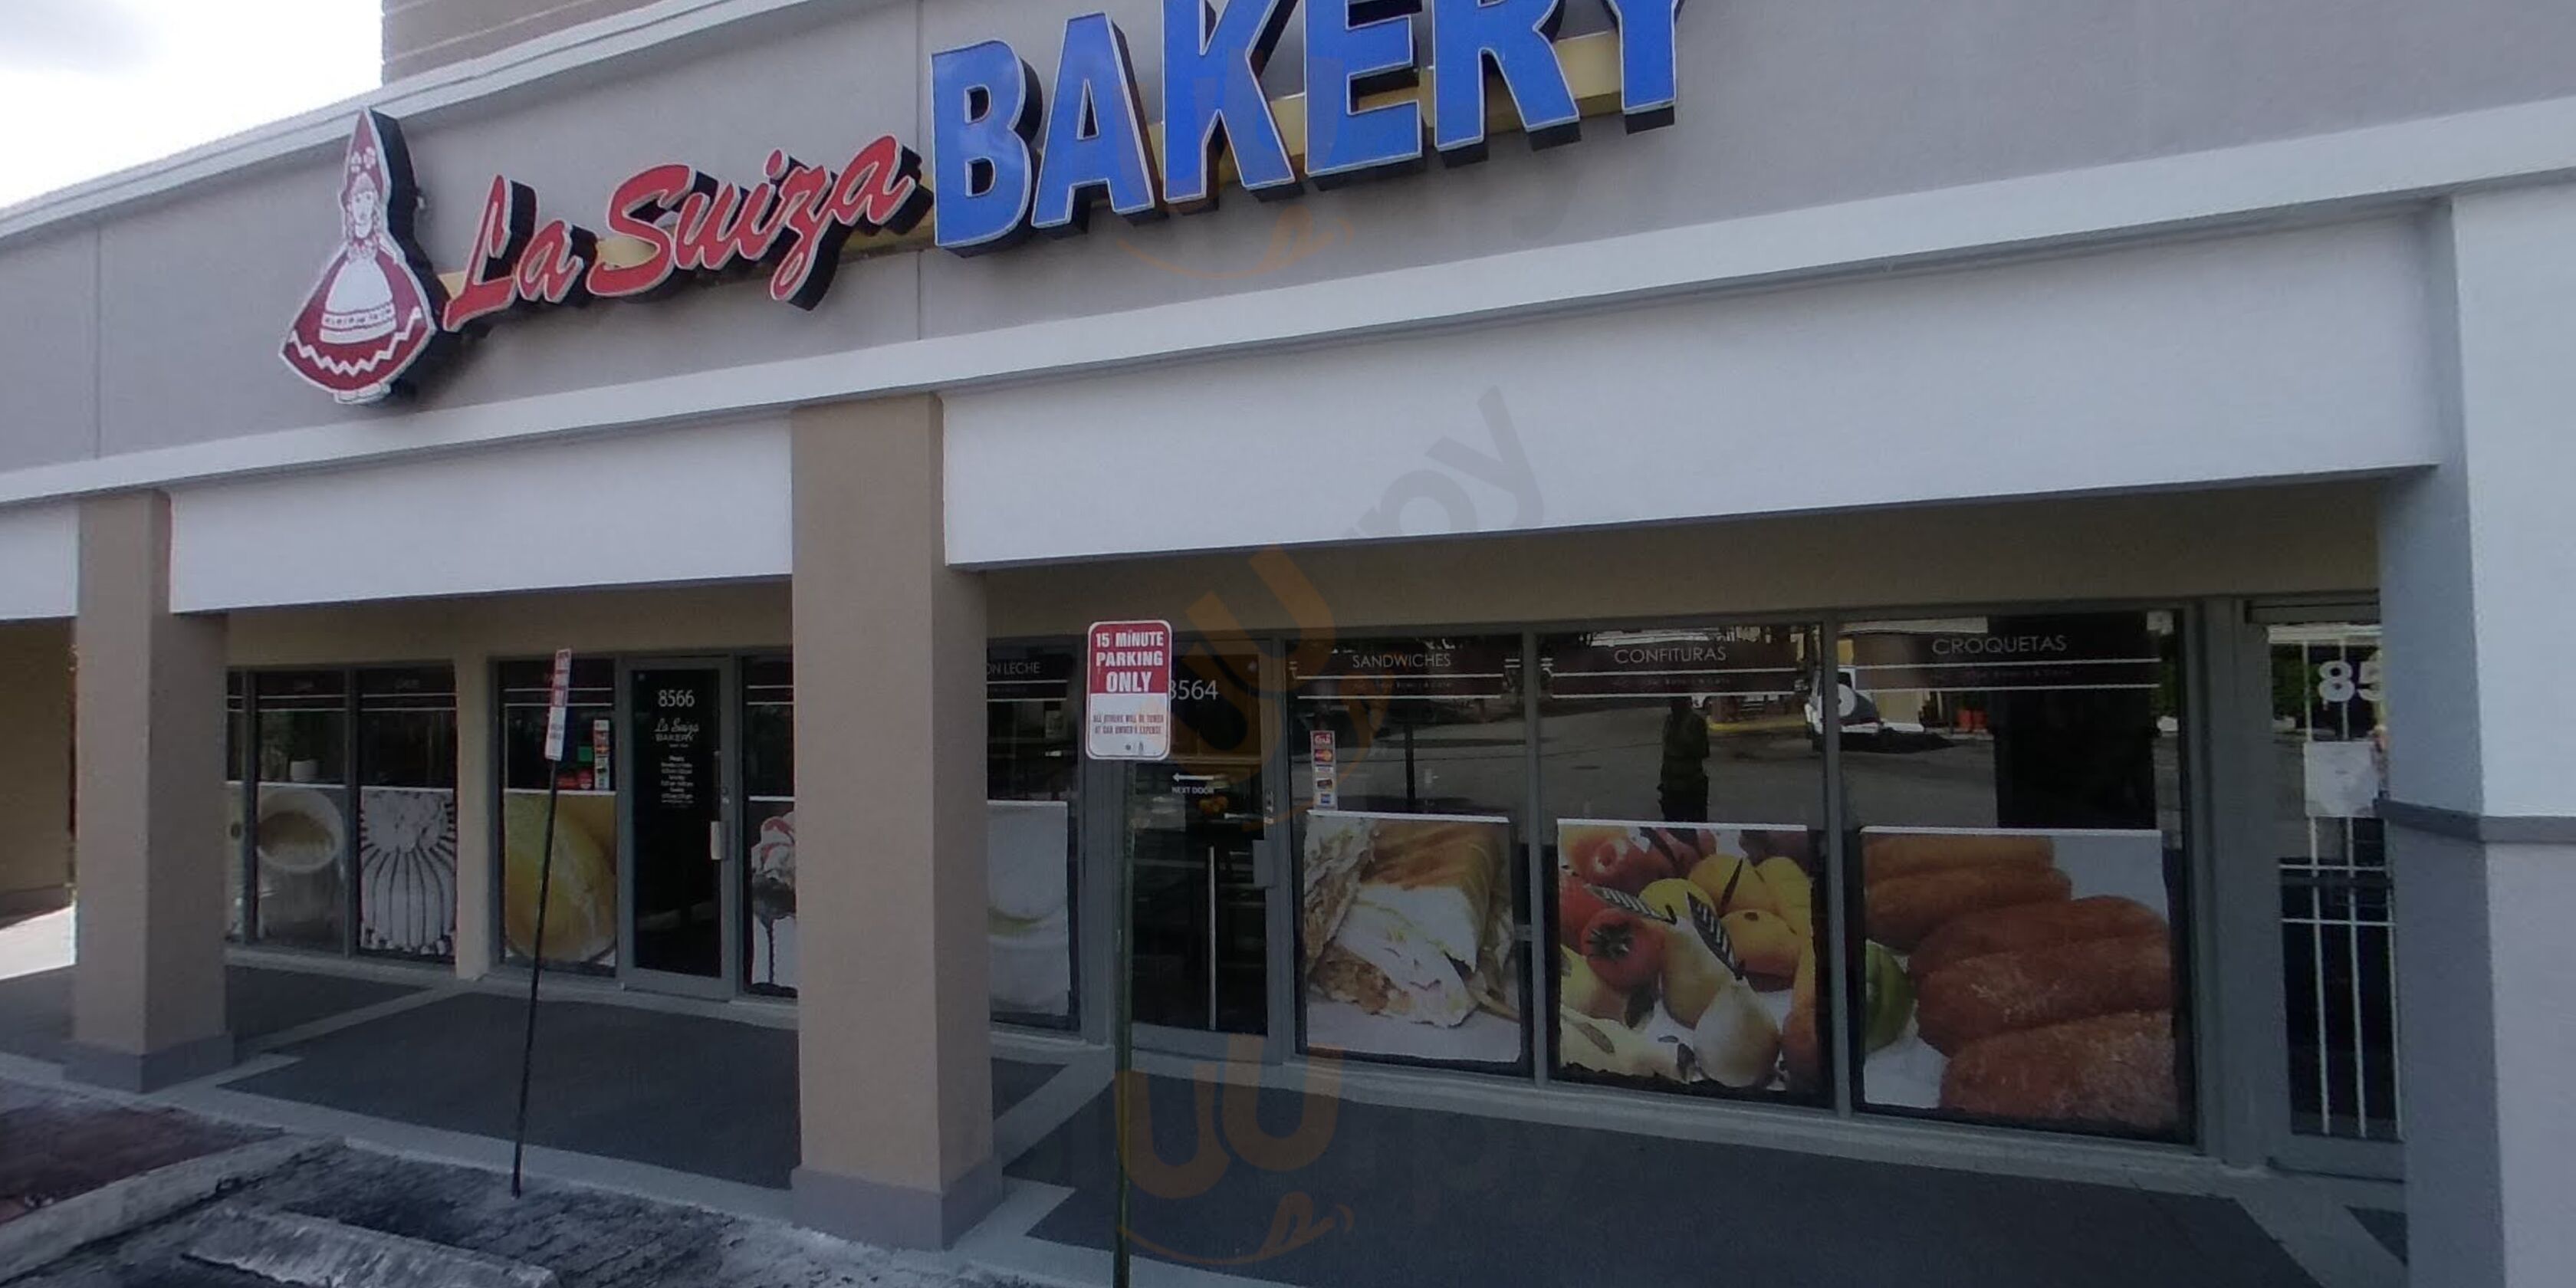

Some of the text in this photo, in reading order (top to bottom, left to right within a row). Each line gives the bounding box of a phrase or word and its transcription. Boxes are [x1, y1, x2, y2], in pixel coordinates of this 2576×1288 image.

[442, 0, 1681, 333] La Suiza BAKERY
[1096, 632, 1165, 648] 15 MINUTE
[1932, 635, 2068, 656] CROQUETAS
[1096, 651, 1164, 667] PARKING
[1352, 653, 1452, 669] SANDWICHES
[1614, 646, 1727, 665] CONFITURAS
[1004, 662, 1040, 675] LECHE
[1106, 671, 1153, 692] ONLY
[658, 689, 695, 708] 8566
[1171, 786, 1214, 794] NEXT DOOR
